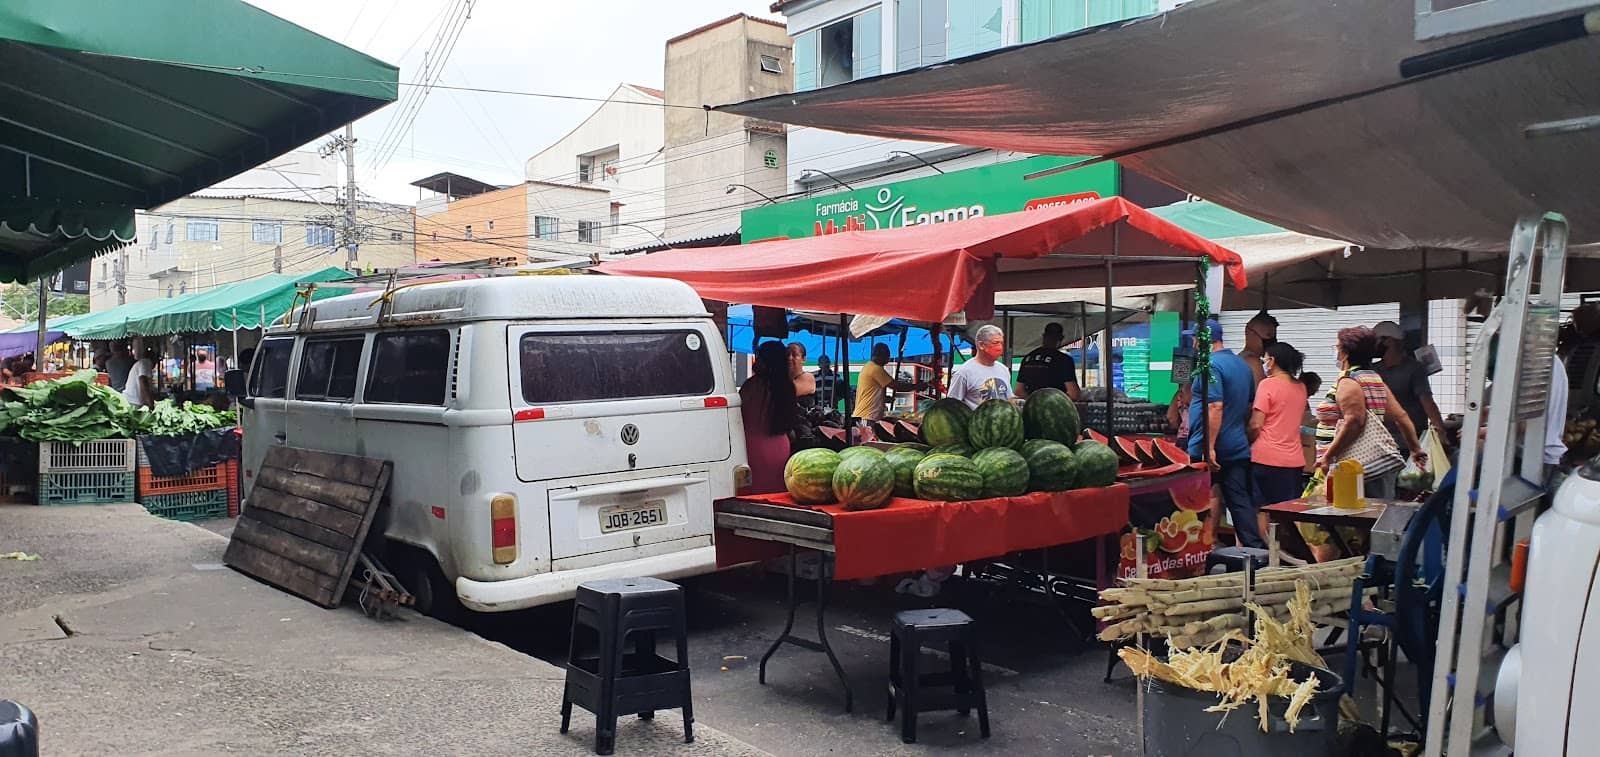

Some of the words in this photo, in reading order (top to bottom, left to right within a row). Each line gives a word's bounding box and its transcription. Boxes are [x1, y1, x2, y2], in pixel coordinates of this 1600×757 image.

[816, 199, 859, 217] Farmácia
[1124, 559, 1162, 579] Ceral
[1162, 556, 1184, 570] das
